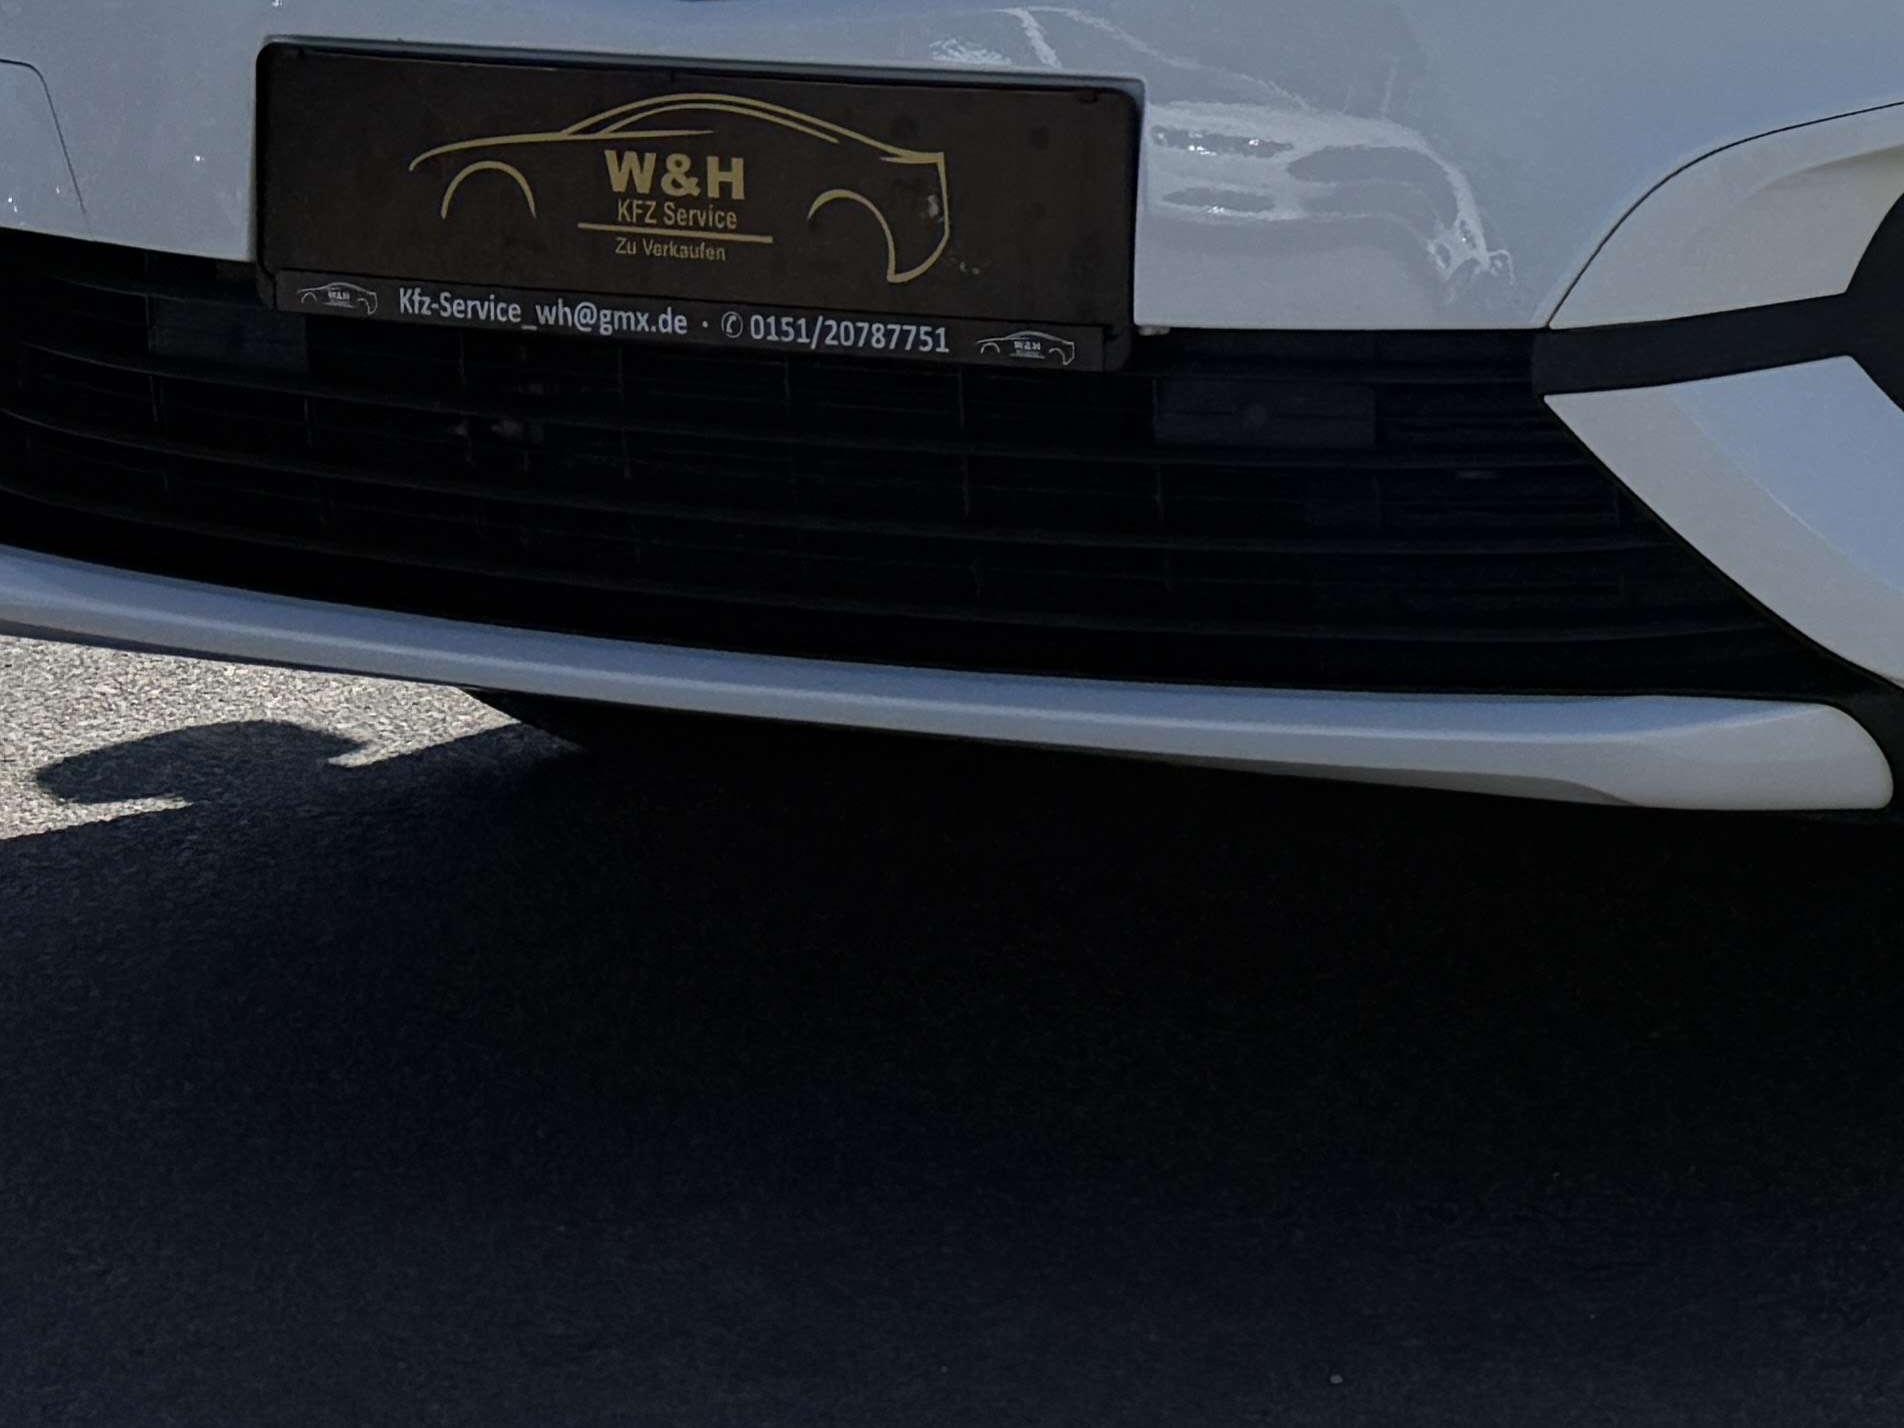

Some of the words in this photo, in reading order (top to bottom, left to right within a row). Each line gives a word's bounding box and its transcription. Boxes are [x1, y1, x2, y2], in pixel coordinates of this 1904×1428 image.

[604, 149, 745, 200] W&H
[617, 198, 657, 224] KFZ
[663, 200, 737, 229] Service
[615, 236, 637, 255] Zu
[642, 239, 726, 261] Verkaufen
[399, 287, 688, 336] Kfz-Service_wh@gmx.de
[750, 313, 950, 353] 0151/20787751
